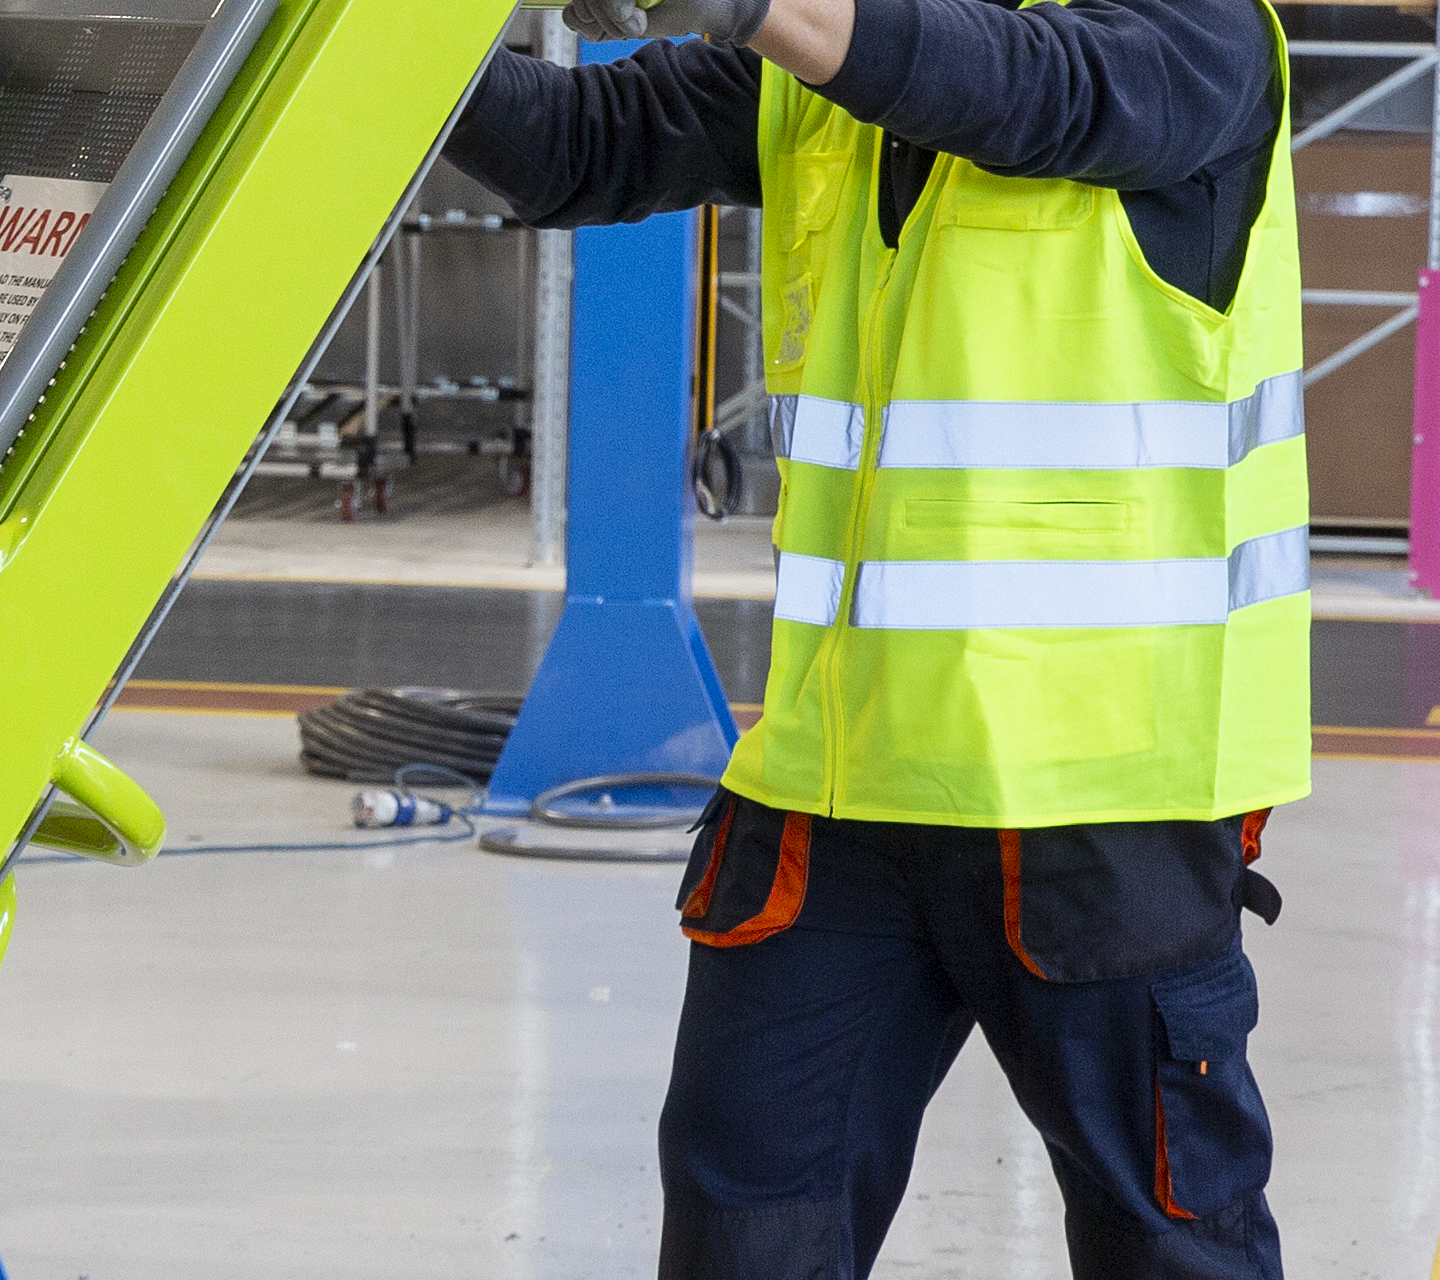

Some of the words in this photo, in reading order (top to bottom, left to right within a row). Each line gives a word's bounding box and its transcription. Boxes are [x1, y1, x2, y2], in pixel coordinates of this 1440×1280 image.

[9, 275, 25, 286] THE
[7, 294, 28, 306] USED
[26, 296, 40, 307] BY
[8, 313, 23, 324] ON
[1, 332, 17, 343] THE
